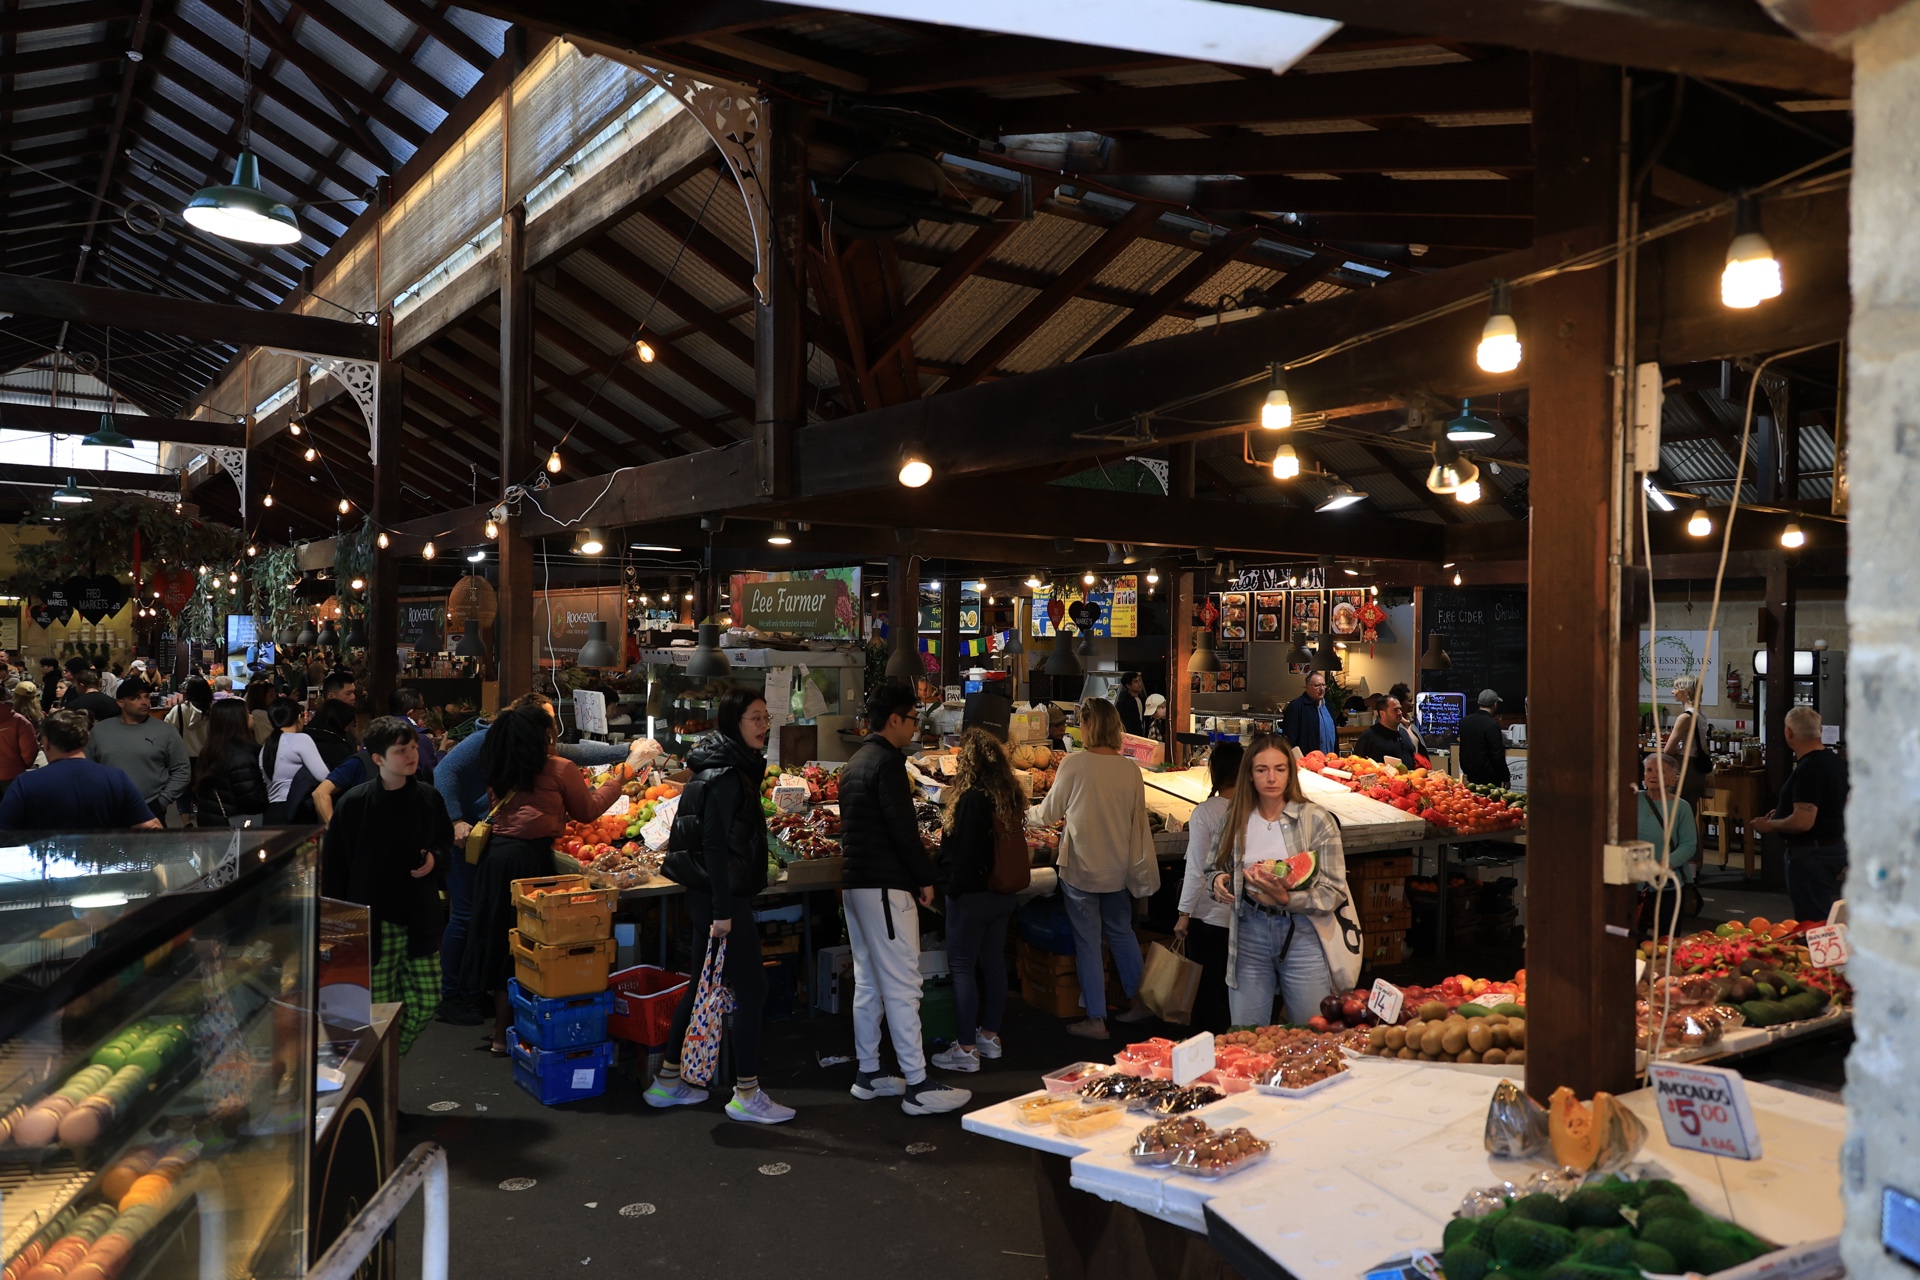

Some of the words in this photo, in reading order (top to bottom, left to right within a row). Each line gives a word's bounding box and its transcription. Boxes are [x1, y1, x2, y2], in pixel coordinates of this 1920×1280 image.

[79, 599, 109, 610] MARKETS
[751, 589, 773, 613] Lee
[777, 587, 826, 612] Farmer
[1458, 610, 1485, 625] CIDER
[1658, 1080, 1731, 1106] AVOCADOS
